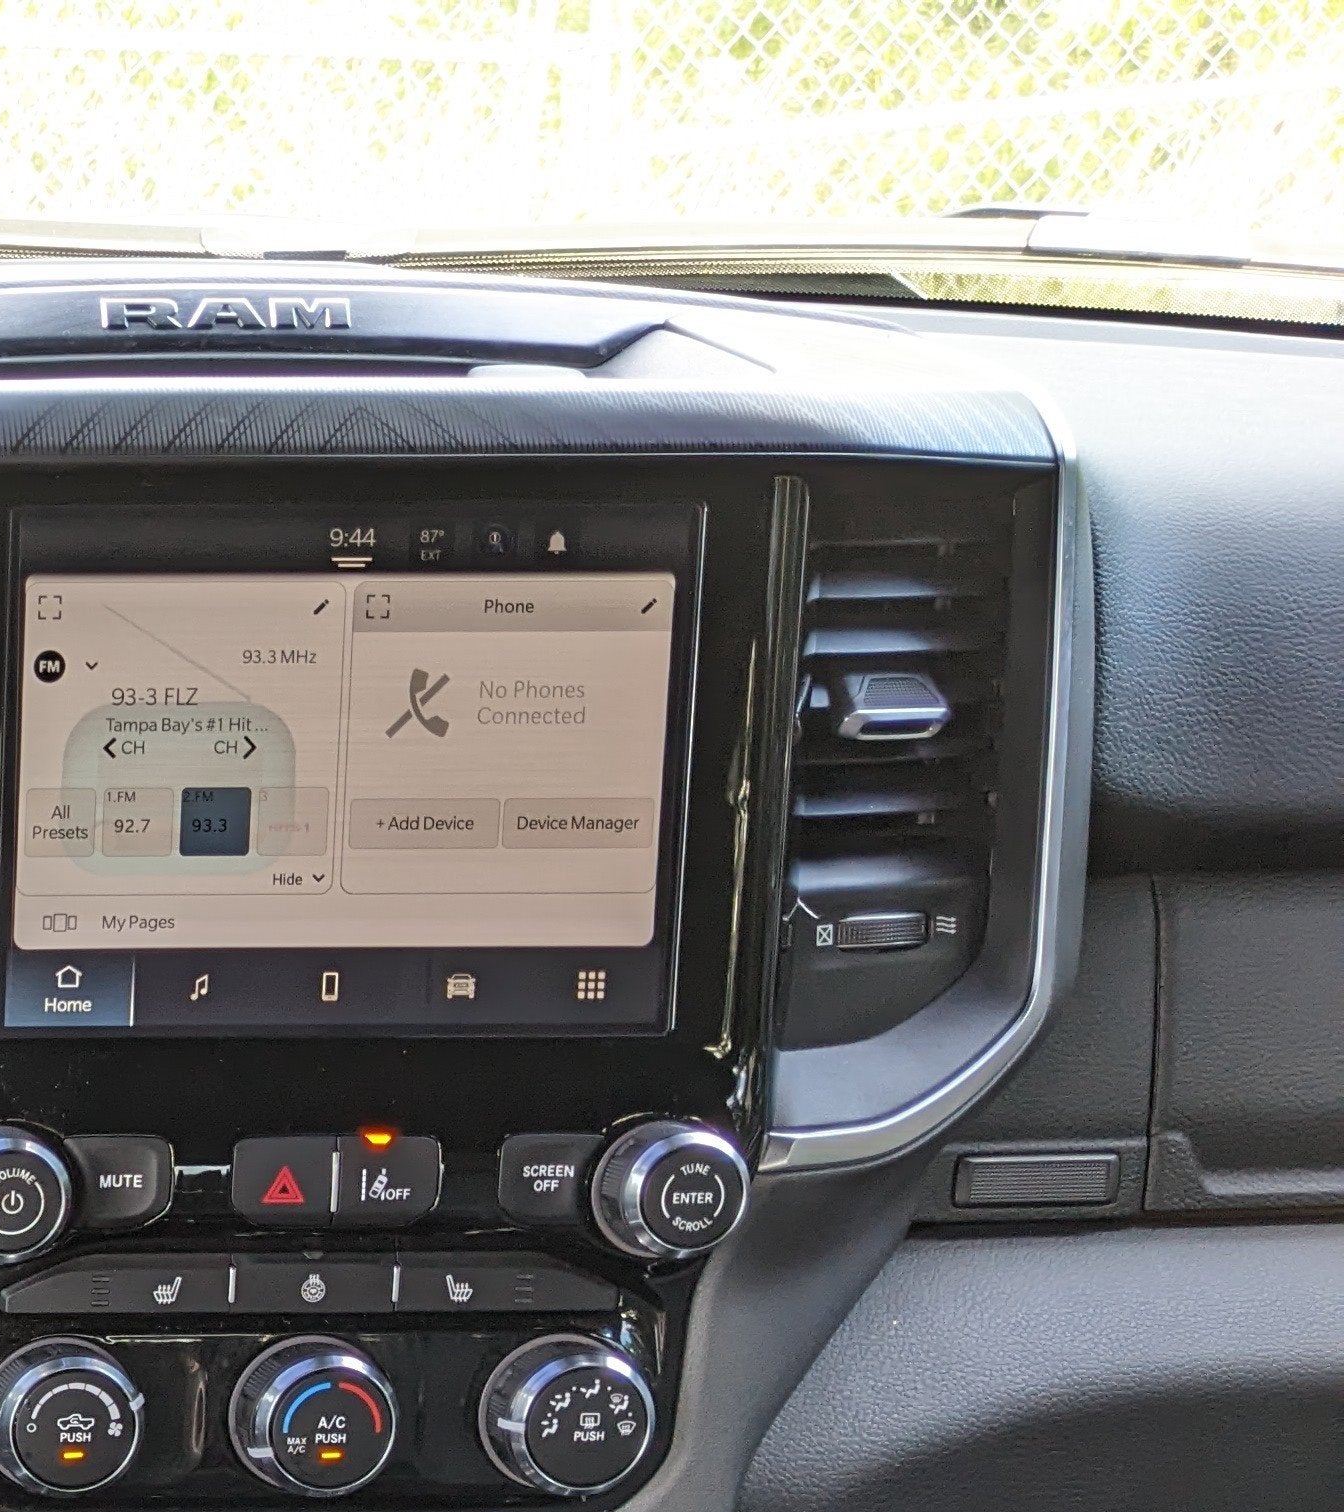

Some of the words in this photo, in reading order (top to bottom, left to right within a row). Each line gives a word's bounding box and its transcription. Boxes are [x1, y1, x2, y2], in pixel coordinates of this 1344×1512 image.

[100, 297, 351, 329] RAM
[330, 528, 376, 548] 9:44
[484, 599, 534, 614] Phone
[242, 650, 277, 664] 93.3
[280, 650, 317, 664] MHz
[39, 660, 60, 674] FM
[111, 688, 157, 706] 93-3
[164, 688, 199, 706] FLZ
[479, 681, 507, 699] No
[514, 681, 585, 699] Phones
[477, 706, 586, 725] Connected
[106, 718, 157, 735] Tampa
[162, 718, 202, 735] Bay's
[206, 718, 223, 732] #1
[228, 718, 252, 732] Hit
[121, 741, 146, 755] CH
[214, 741, 238, 755] CH
[51, 805, 71, 820] All
[114, 819, 150, 834] 92.7
[191, 818, 228, 833] 93.3
[387, 816, 419, 831] Add
[423, 816, 474, 831] Device
[517, 816, 567, 831] Device
[571, 816, 639, 834] Manager
[32, 826, 88, 840] Presets
[272, 873, 303, 886] Hide
[102, 916, 126, 931] My
[131, 916, 175, 931] Pages
[44, 998, 92, 1013] Home
[523, 1165, 574, 1178] SCREEN
[680, 1163, 711, 1176] TUNE
[99, 1175, 143, 1189] MUTE
[533, 1180, 559, 1192] OFF
[387, 1188, 411, 1201] OFF
[673, 1192, 713, 1205] ENTER
[672, 1216, 713, 1232] SCROLL
[317, 1416, 346, 1430] A/C
[60, 1432, 92, 1443] PUSH
[287, 1437, 307, 1445] MAX
[315, 1432, 347, 1444] PUSH
[574, 1431, 605, 1442] PUSH
[287, 1445, 306, 1455] A/C
